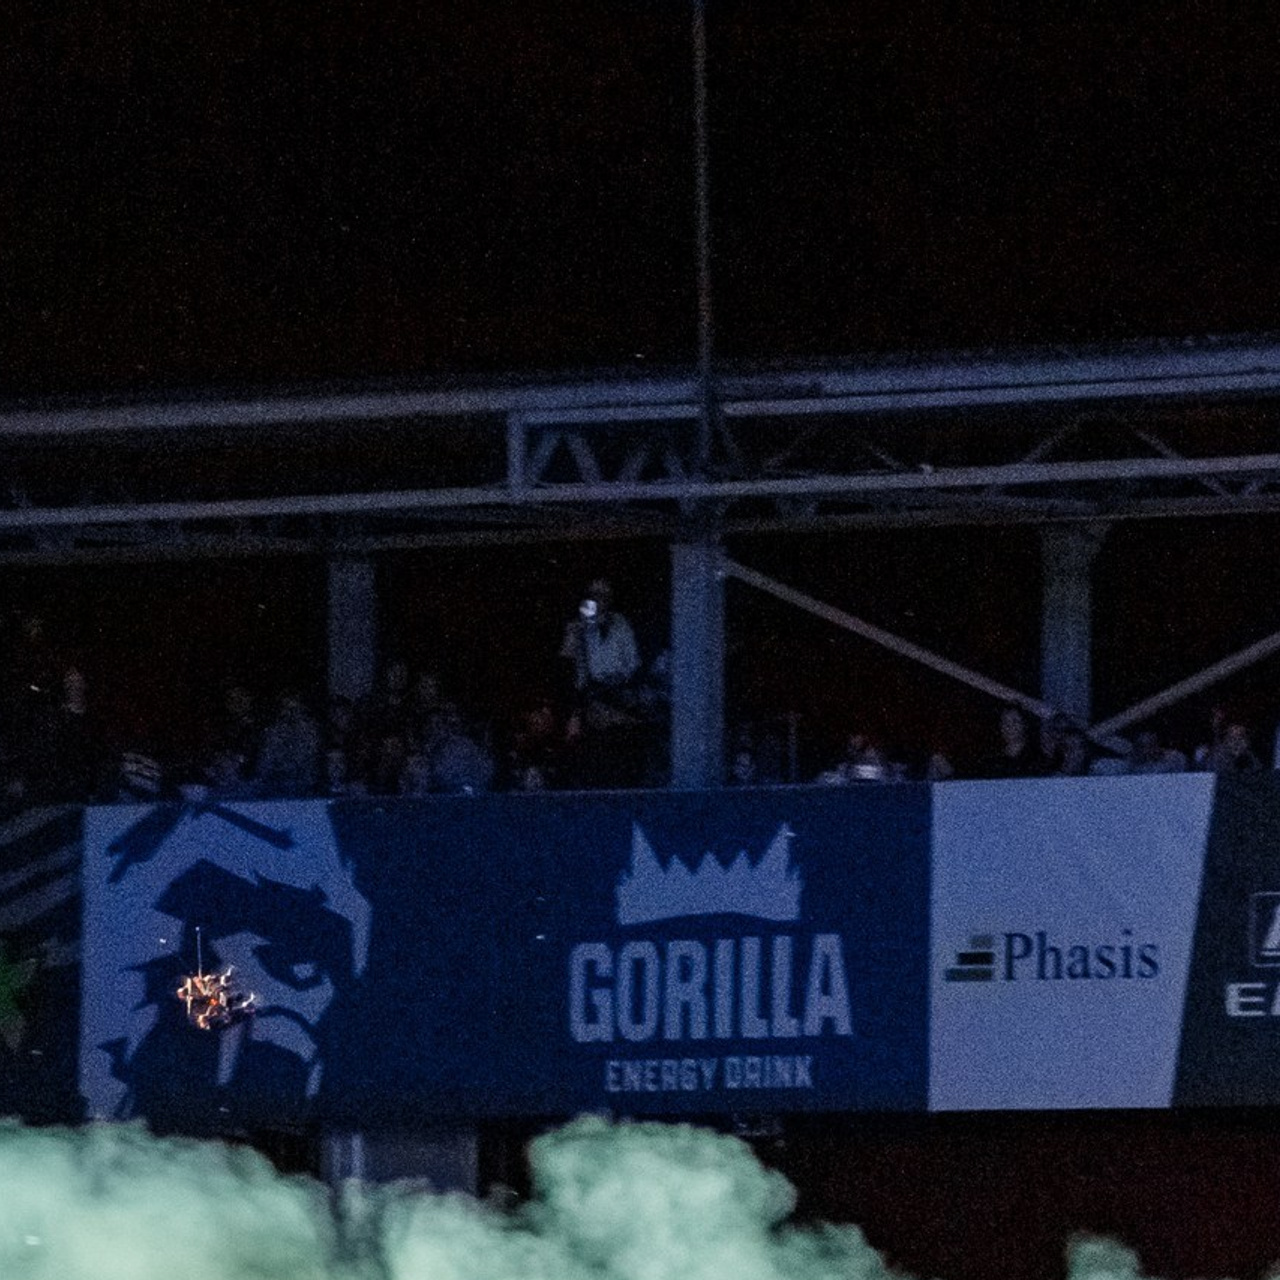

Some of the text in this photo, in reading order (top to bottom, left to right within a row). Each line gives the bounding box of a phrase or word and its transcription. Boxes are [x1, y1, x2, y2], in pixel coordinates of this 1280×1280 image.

[1003, 929, 1159, 982] Phasis
[569, 934, 852, 1043] GORILLA
[605, 1055, 813, 1092] ENERGY DRINK
